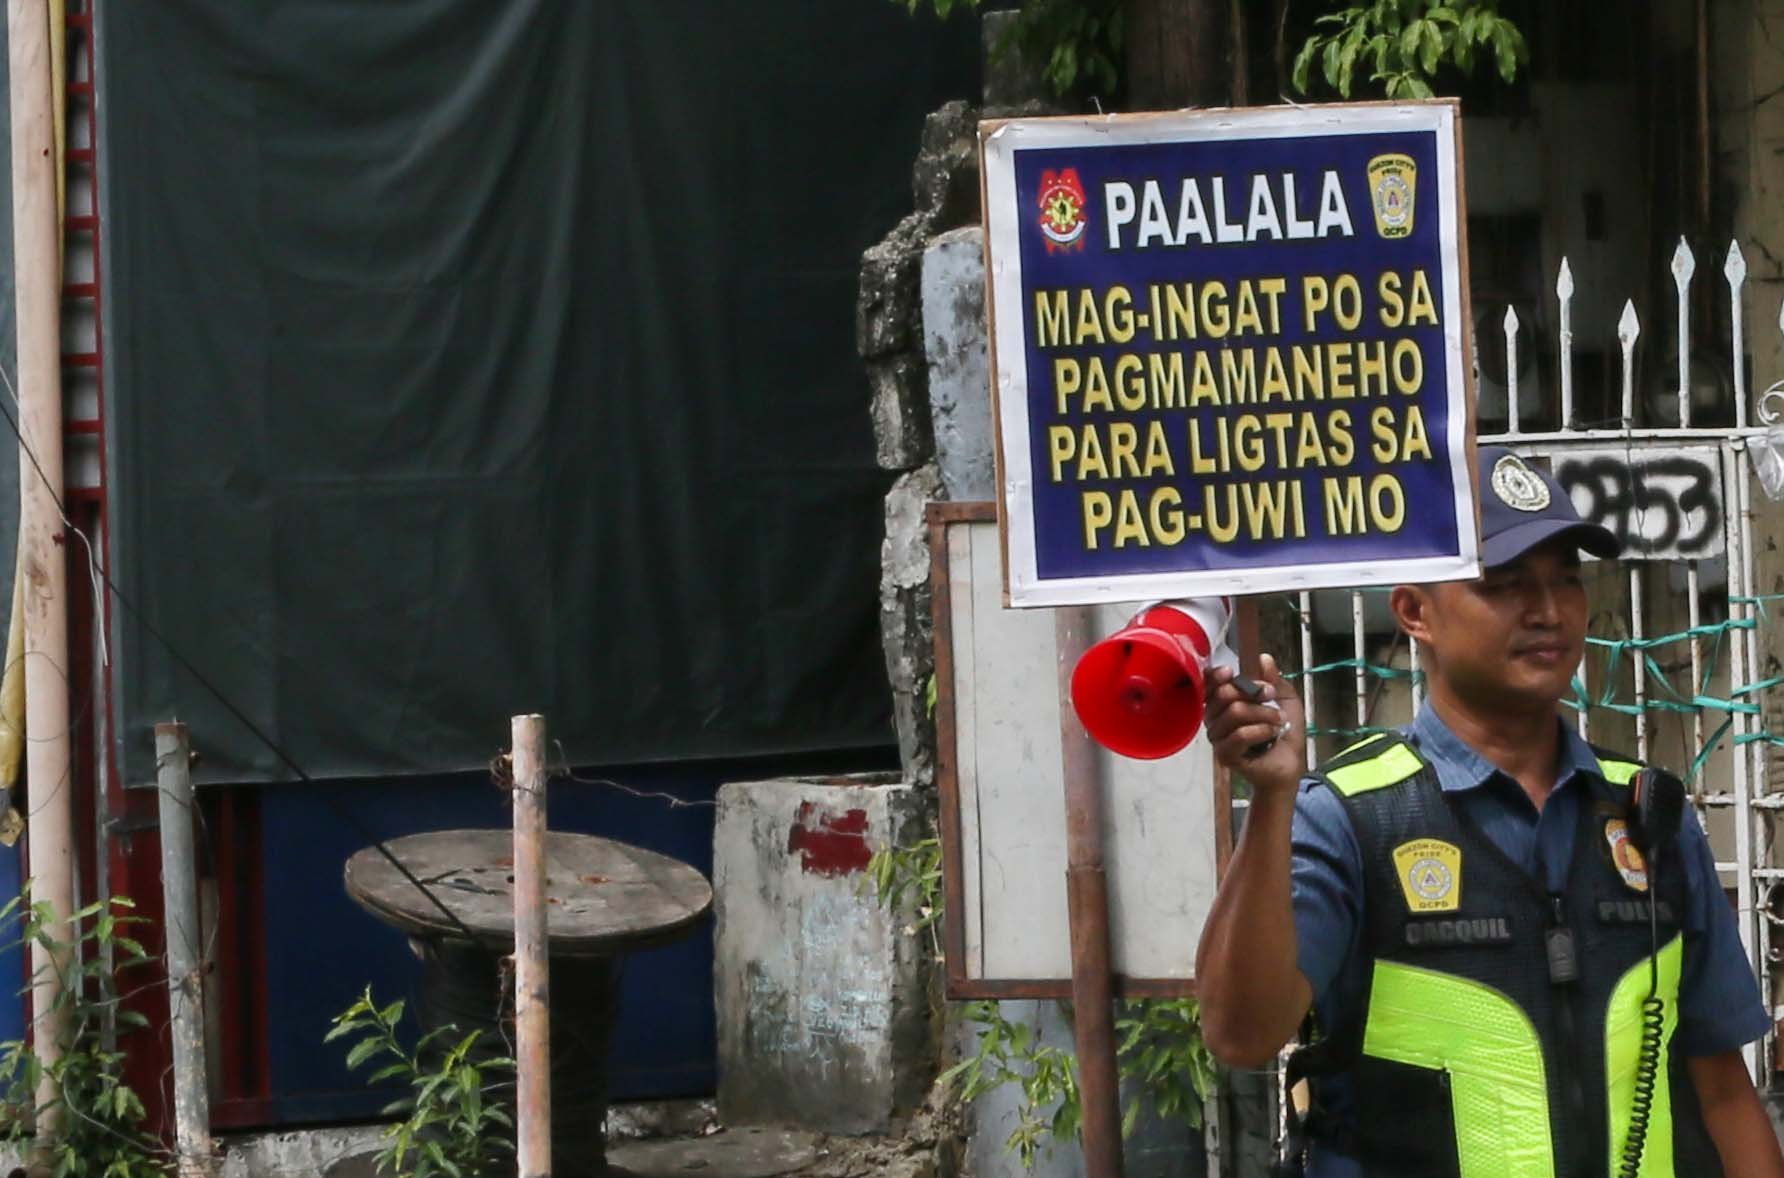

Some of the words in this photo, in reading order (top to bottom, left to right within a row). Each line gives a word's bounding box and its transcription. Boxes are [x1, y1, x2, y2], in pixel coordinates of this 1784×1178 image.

[1104, 170, 1355, 249] PAALALA
[1034, 277, 1287, 348] MAG-INGAT
[1303, 273, 1363, 332] PO
[1378, 269, 1439, 328] SA
[1054, 338, 1424, 415] PAGMAMANEHO
[1049, 417, 1175, 482] PARA
[1188, 409, 1355, 474] LIGTAS
[1371, 405, 1433, 464] SA
[1082, 479, 1306, 550] PAG-UWI
[1323, 473, 1405, 536] MO
